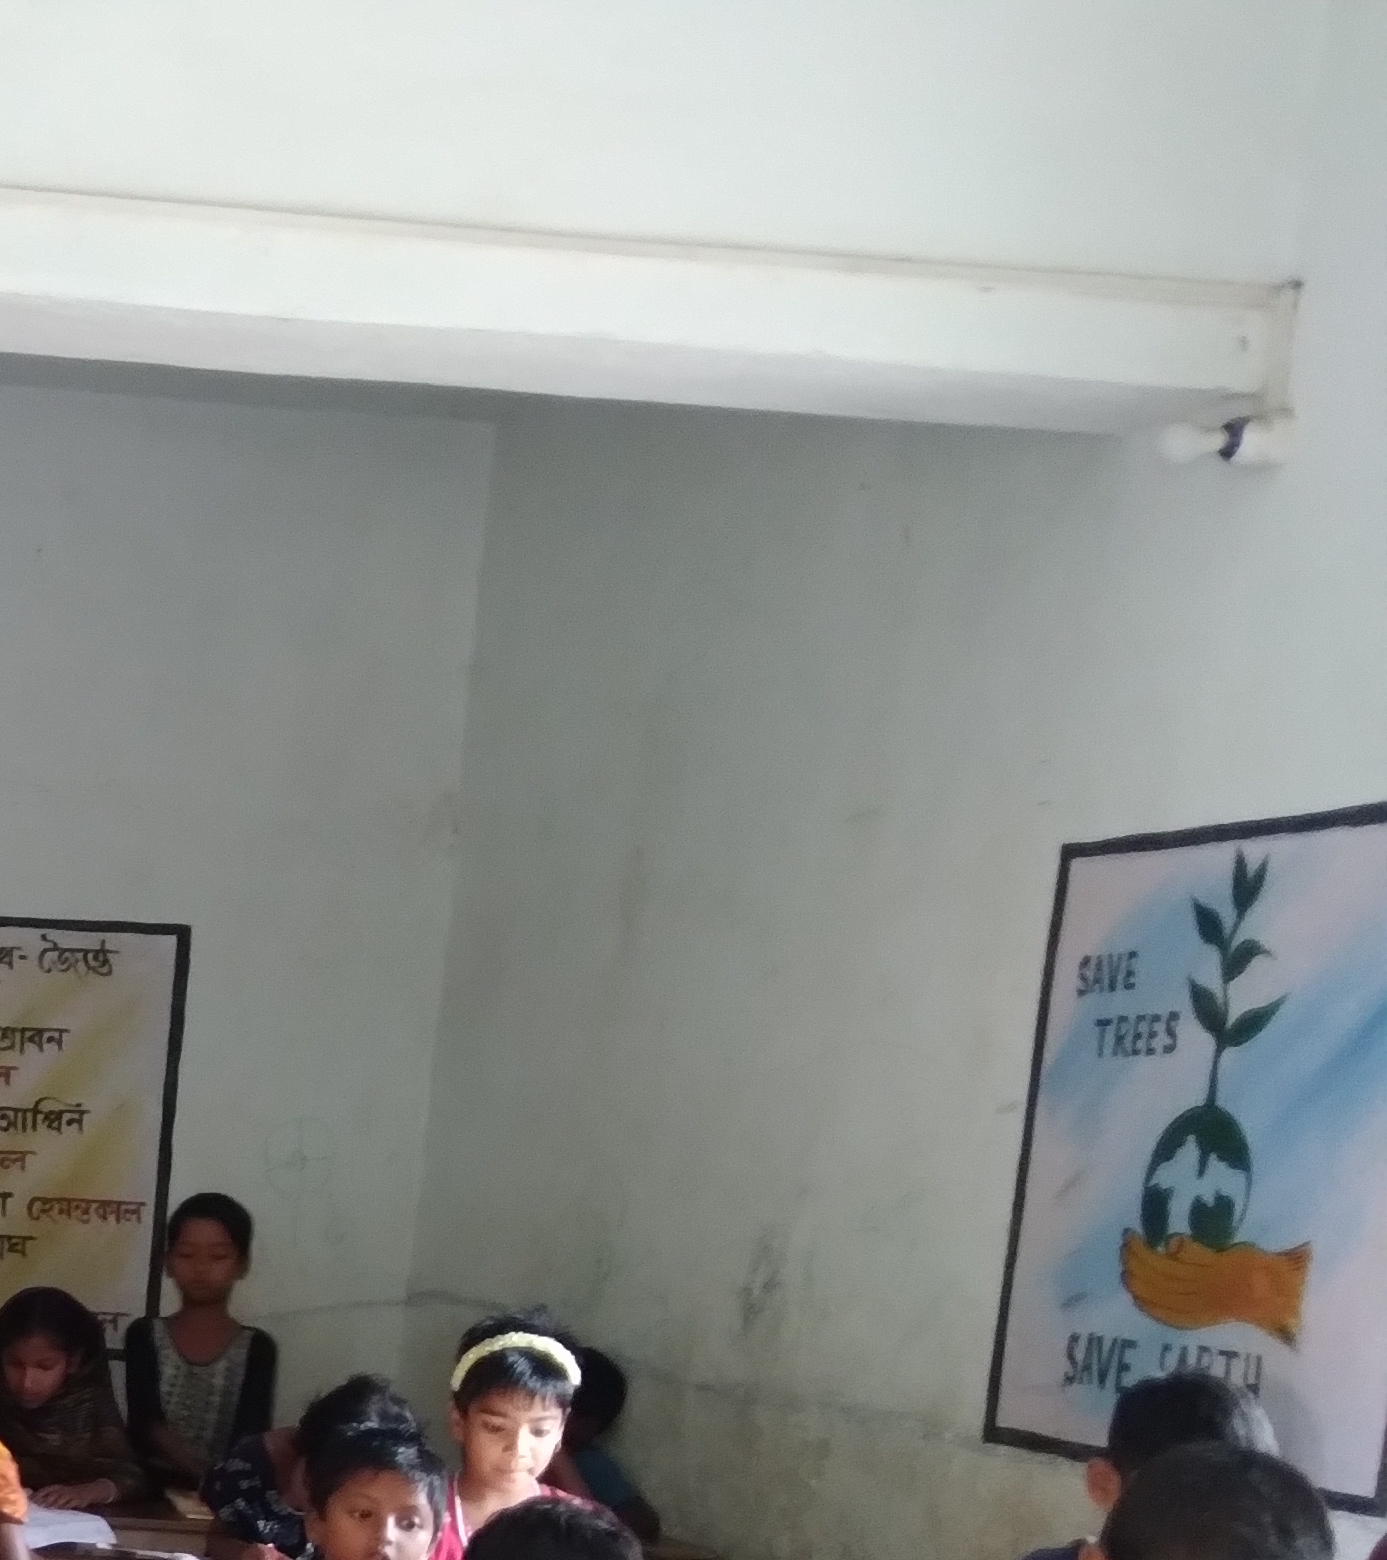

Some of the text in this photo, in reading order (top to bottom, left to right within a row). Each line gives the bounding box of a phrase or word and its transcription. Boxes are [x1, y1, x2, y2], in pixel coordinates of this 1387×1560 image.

[1076, 950, 1138, 998] SAVE
[1094, 1010, 1180, 1058] TREES
[1063, 1332, 1137, 1394] SAVE
